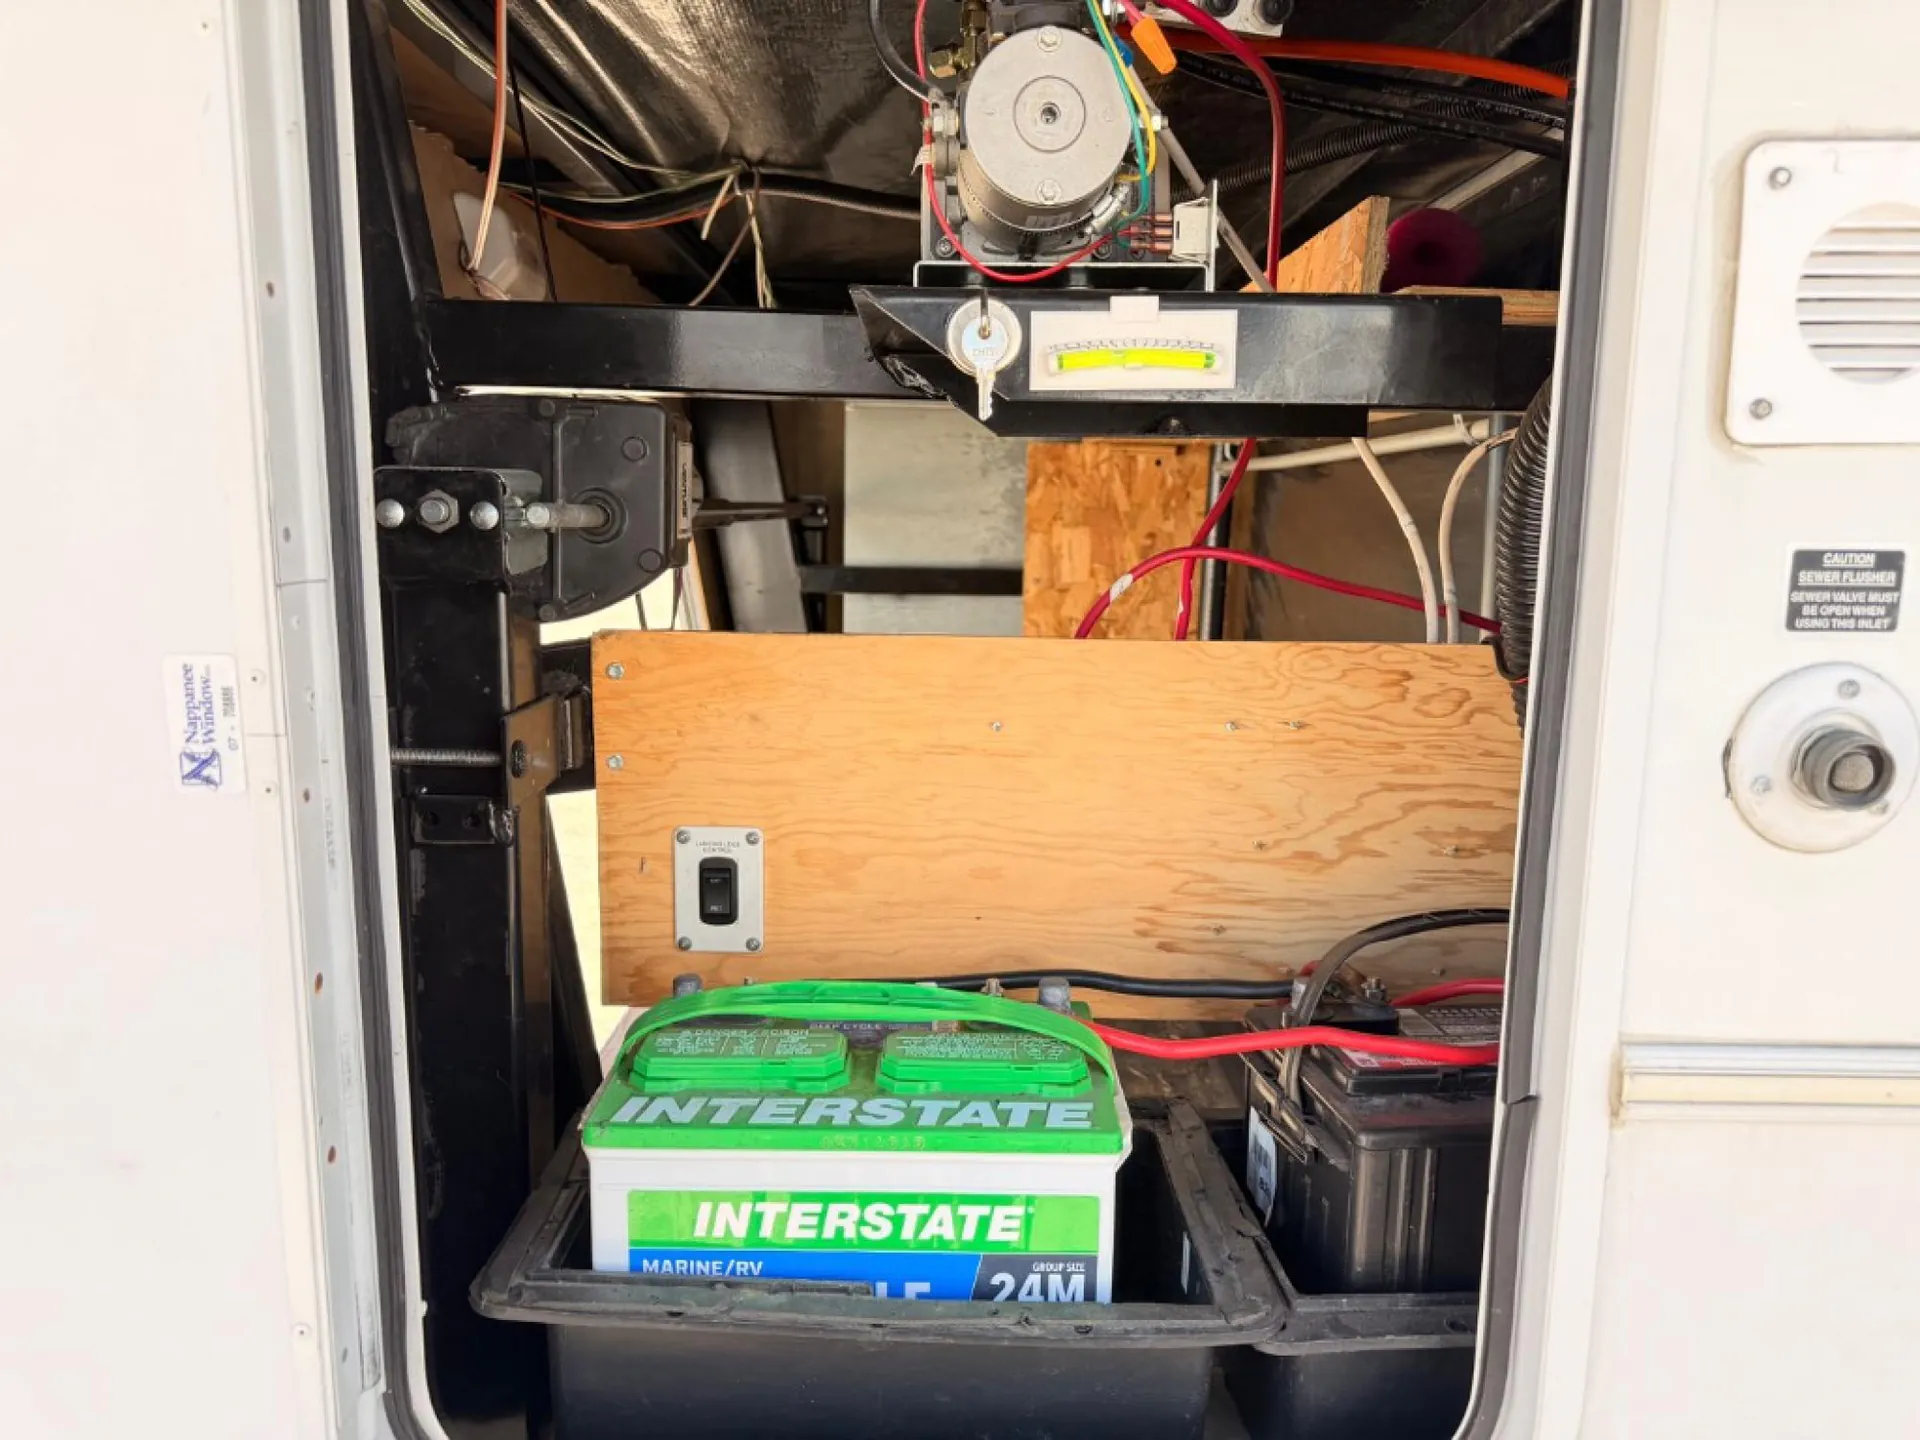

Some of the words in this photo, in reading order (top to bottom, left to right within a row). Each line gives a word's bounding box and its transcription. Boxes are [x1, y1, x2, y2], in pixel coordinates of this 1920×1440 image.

[1822, 552, 1876, 565] CAUTION
[1798, 570, 1841, 583] SEWER
[1842, 570, 1896, 584] FLUSHER
[1790, 591, 1831, 602] SEWER
[1832, 591, 1867, 602] VALVE
[1867, 591, 1900, 603] MUST
[1802, 604, 1818, 615] BE
[1819, 604, 1851, 616] OPEN
[1852, 605, 1886, 616] WHEN
[1795, 617, 1830, 628] USING
[1831, 618, 1855, 628] THIS
[1857, 618, 1889, 629] INLET
[182, 663, 202, 744] Nappanee
[199, 675, 216, 745] Window
[610, 1097, 1094, 1128] INTERSTATE
[693, 1201, 1025, 1242] INTERSTATE
[642, 1259, 763, 1276] MARINE/RV
[1032, 1261, 1063, 1272] GROUP
[1065, 1262, 1085, 1272] SIZE
[989, 1272, 1085, 1302] 24M
